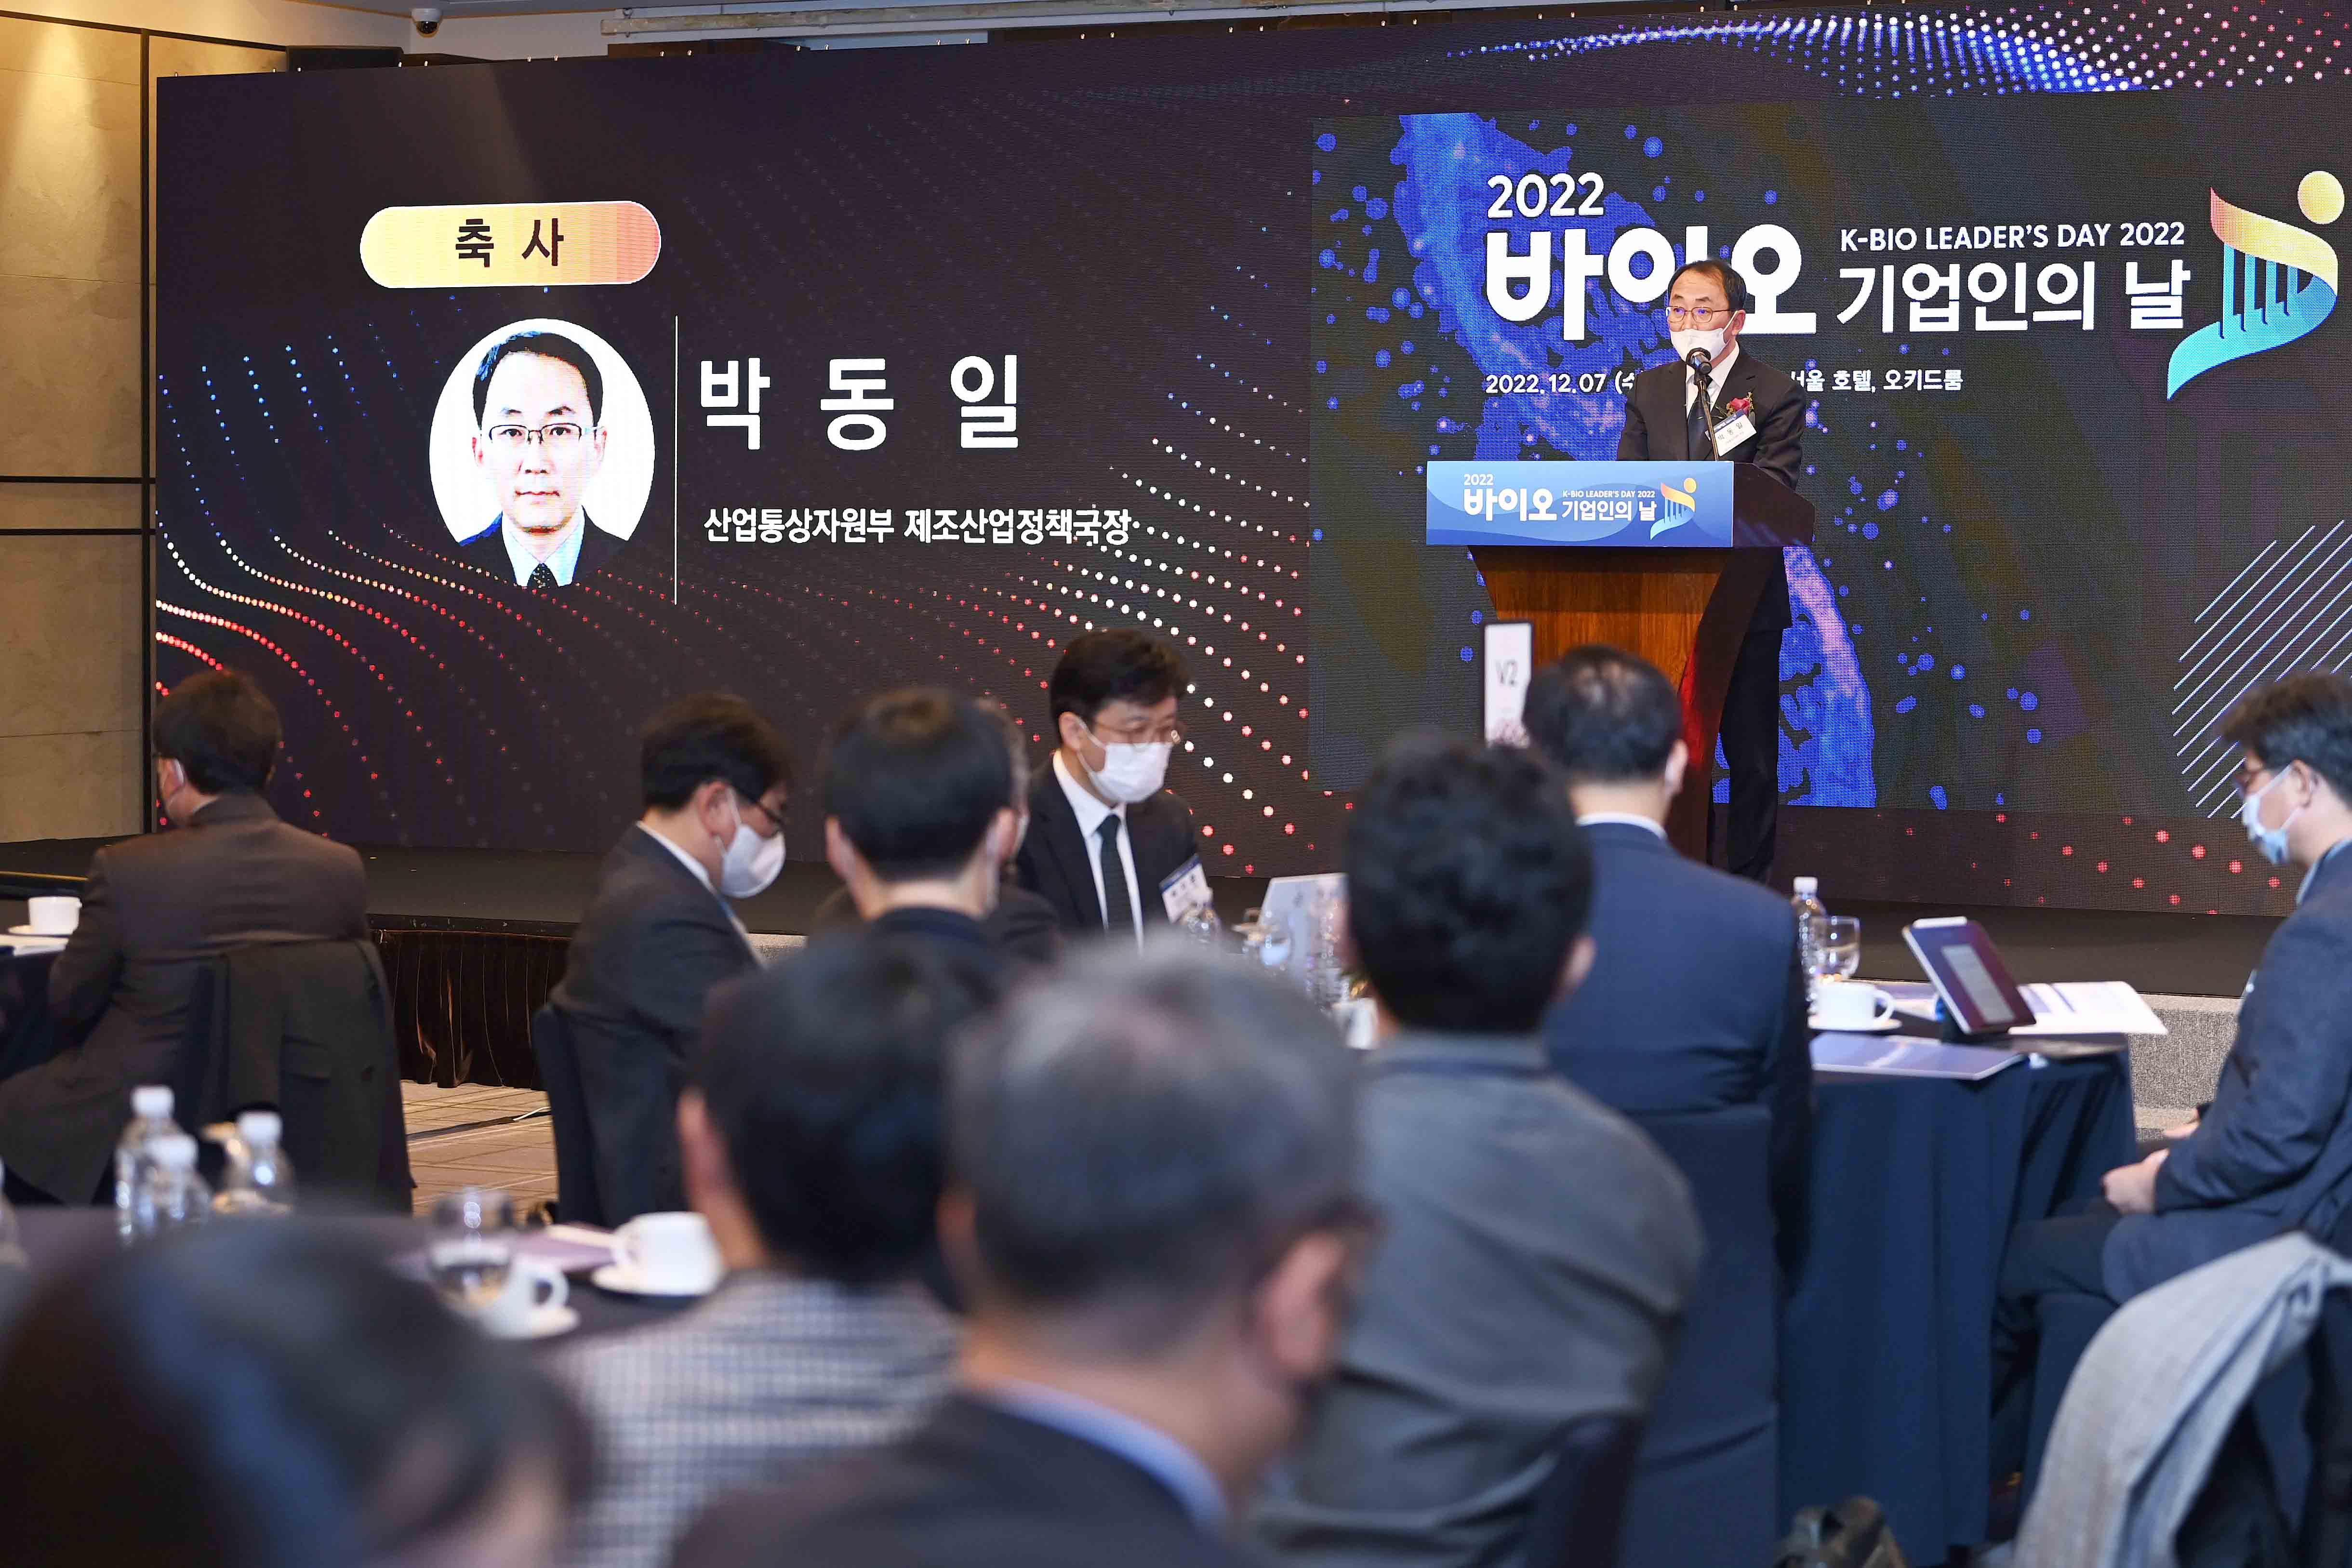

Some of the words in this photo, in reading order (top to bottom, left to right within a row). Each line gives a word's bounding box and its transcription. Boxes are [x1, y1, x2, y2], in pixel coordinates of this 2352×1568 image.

[1488, 172, 1604, 218] 2022
[1841, 227, 1917, 252] K-BIO
[2057, 223, 2112, 247] DAY
[2120, 222, 2184, 246] 2022
[1836, 261, 2095, 333] 기업인의
[2125, 259, 2191, 329] 날
[1486, 373, 1607, 394] 2022.12.07
[1832, 369, 1876, 394] 호텔,
[1883, 369, 1964, 391] 오키드룸
[1464, 474, 1493, 485] 2022
[1464, 488, 1557, 521] 바이오
[1562, 500, 1632, 521] 기업인의
[1639, 501, 1657, 521] 날
[704, 507, 894, 544] 산업통상자원부
[904, 508, 1132, 545] 제조산업정책국장
